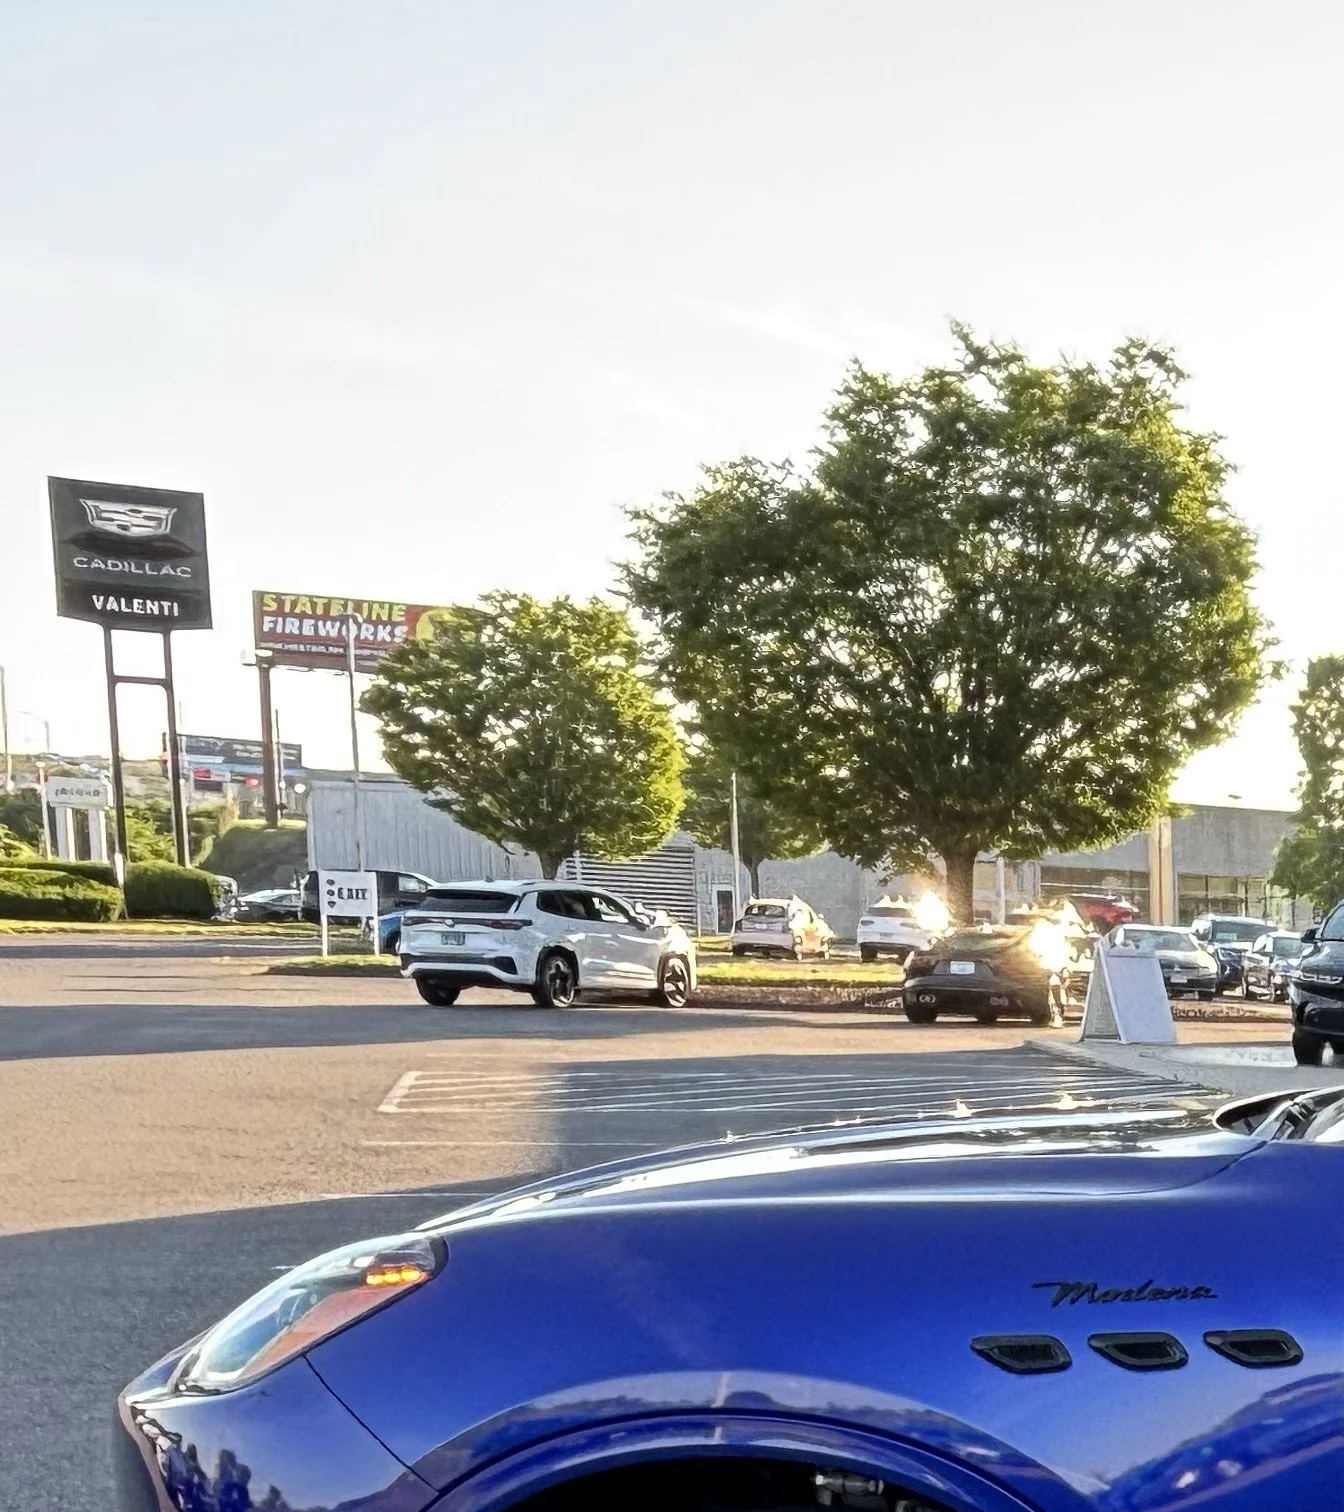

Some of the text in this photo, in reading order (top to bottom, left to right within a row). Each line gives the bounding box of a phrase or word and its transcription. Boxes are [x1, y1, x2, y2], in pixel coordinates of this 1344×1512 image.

[73, 556, 192, 578] CADILLAC
[92, 594, 179, 617] VALENTI
[262, 616, 408, 643] FIREWORKS
[1032, 1279, 1219, 1308] Modena
